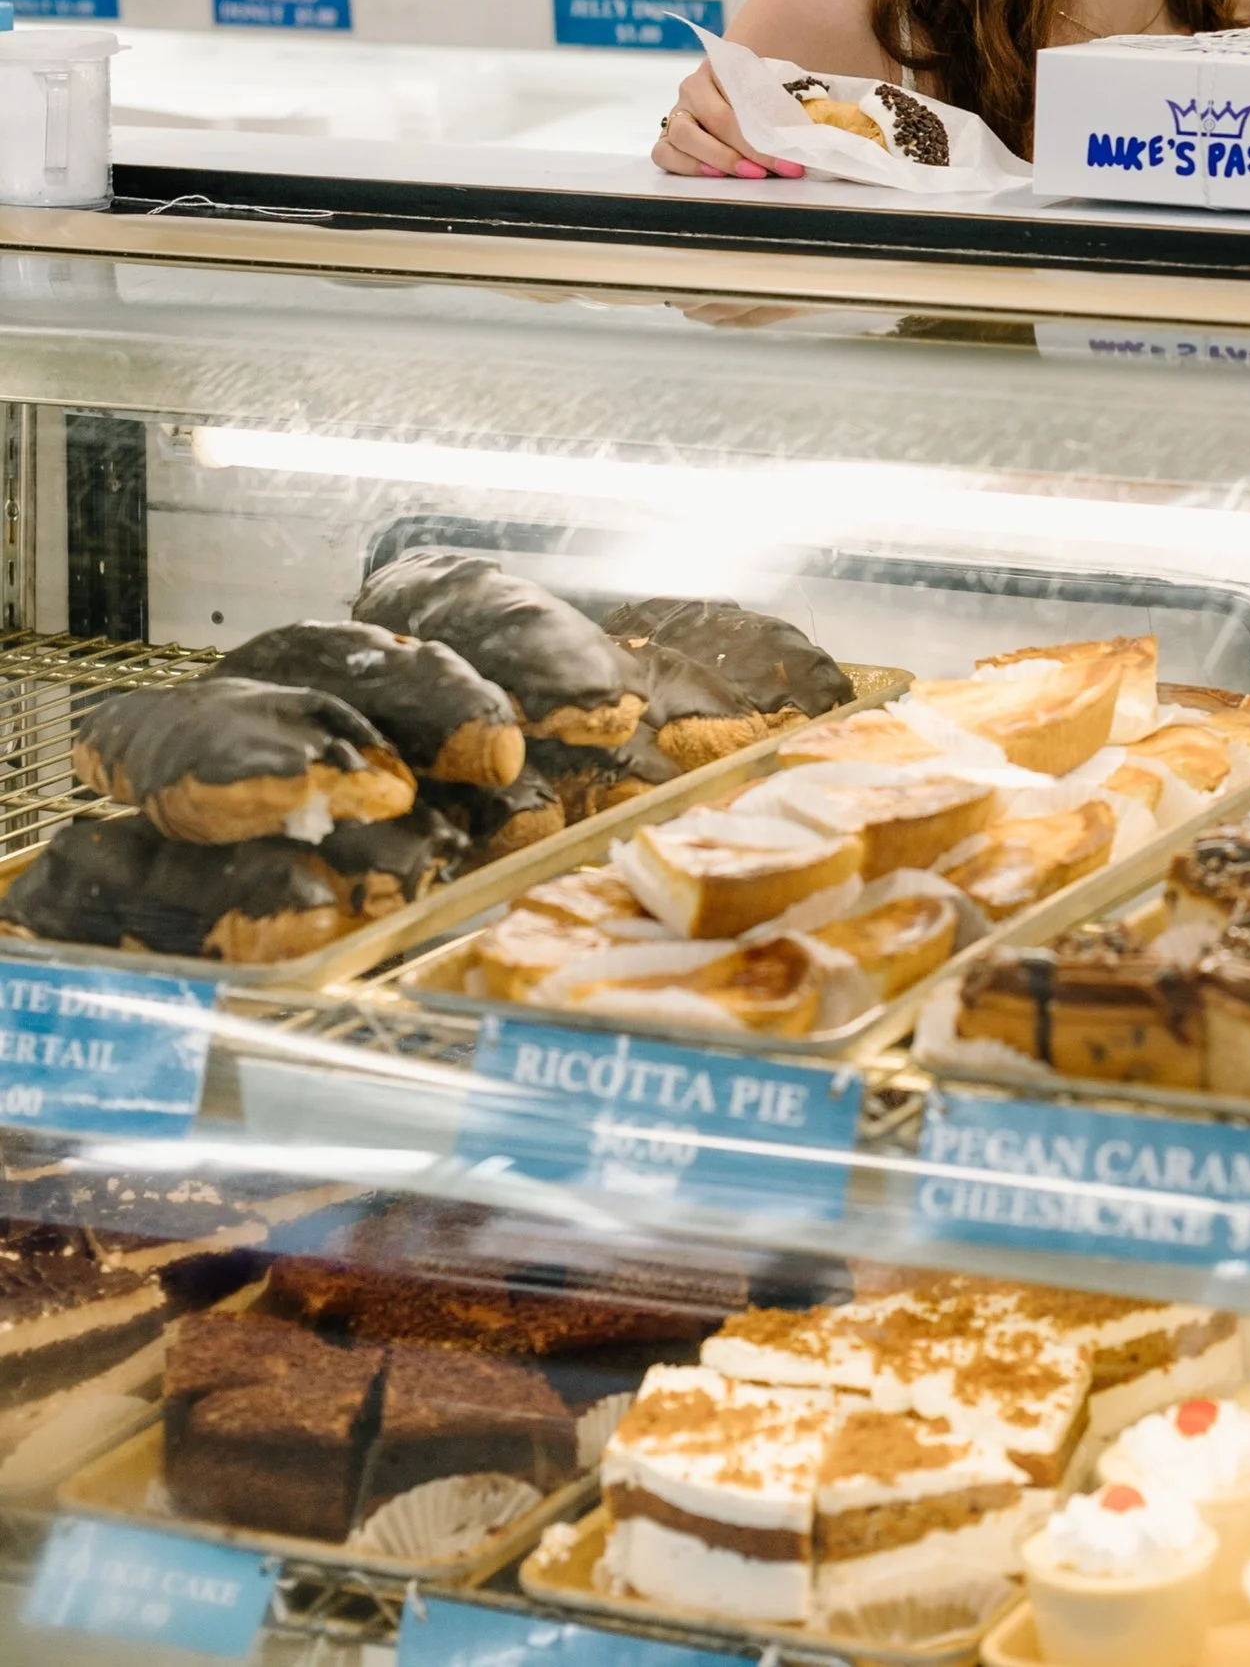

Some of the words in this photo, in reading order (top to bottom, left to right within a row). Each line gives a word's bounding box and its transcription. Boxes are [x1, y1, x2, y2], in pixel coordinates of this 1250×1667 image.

[1087, 132, 1196, 177] MIKE'S
[512, 1041, 716, 1116] RICOTTA
[727, 1075, 808, 1127] PIE
